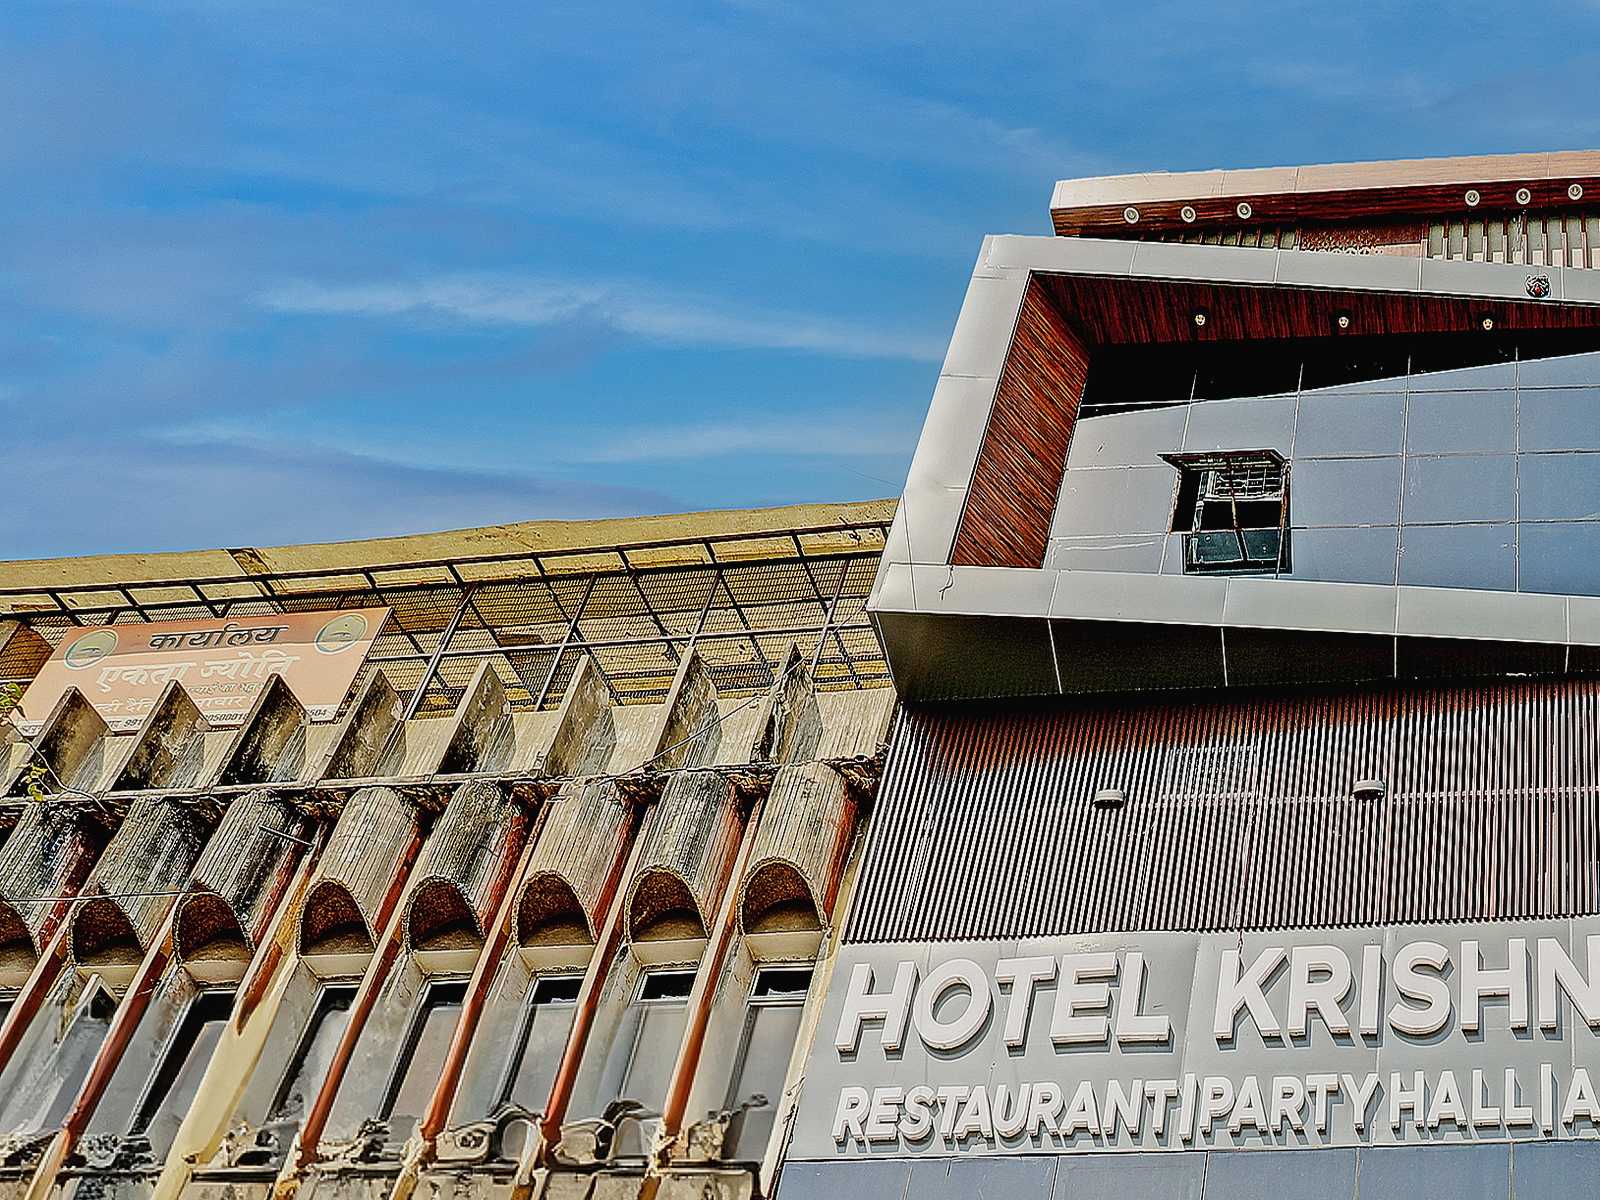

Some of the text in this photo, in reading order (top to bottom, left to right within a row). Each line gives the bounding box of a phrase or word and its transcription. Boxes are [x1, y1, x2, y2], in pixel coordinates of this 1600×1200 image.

[149, 622, 289, 649] कार्यालय
[97, 660, 197, 693] एकता
[834, 950, 1173, 1053] HOTEL
[832, 1079, 1180, 1144] RESTAURANT
[1199, 1072, 1379, 1134] PARTY
[1388, 1067, 1535, 1131] HALL
